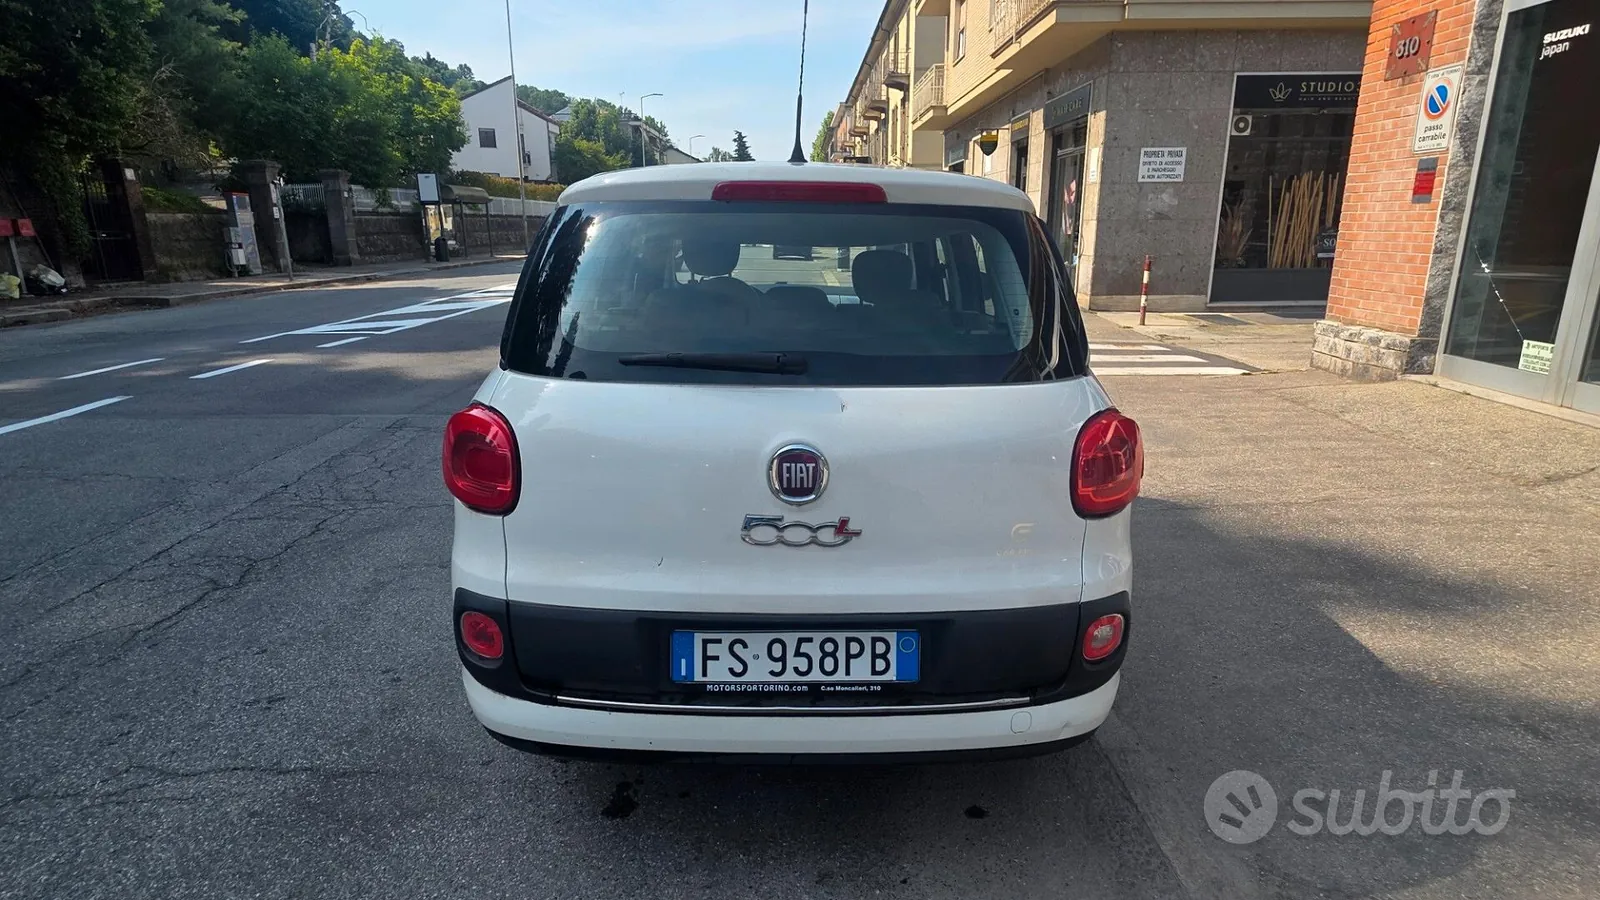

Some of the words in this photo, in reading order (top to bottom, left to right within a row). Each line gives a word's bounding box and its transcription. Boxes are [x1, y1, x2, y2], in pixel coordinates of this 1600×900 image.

[1543, 24, 1590, 43] SUZUKI
[1396, 36, 1420, 59] 310
[1539, 42, 1570, 60] japan
[1418, 132, 1447, 143] carrabile
[1424, 123, 1443, 134] passo
[1167, 150, 1184, 158] PRIVATA
[782, 462, 816, 489] FIAT
[740, 513, 863, 548] 500L
[701, 638, 749, 678] FS
[766, 636, 891, 677] 958PB
[706, 684, 809, 692] MOTORSPORTORINO.com
